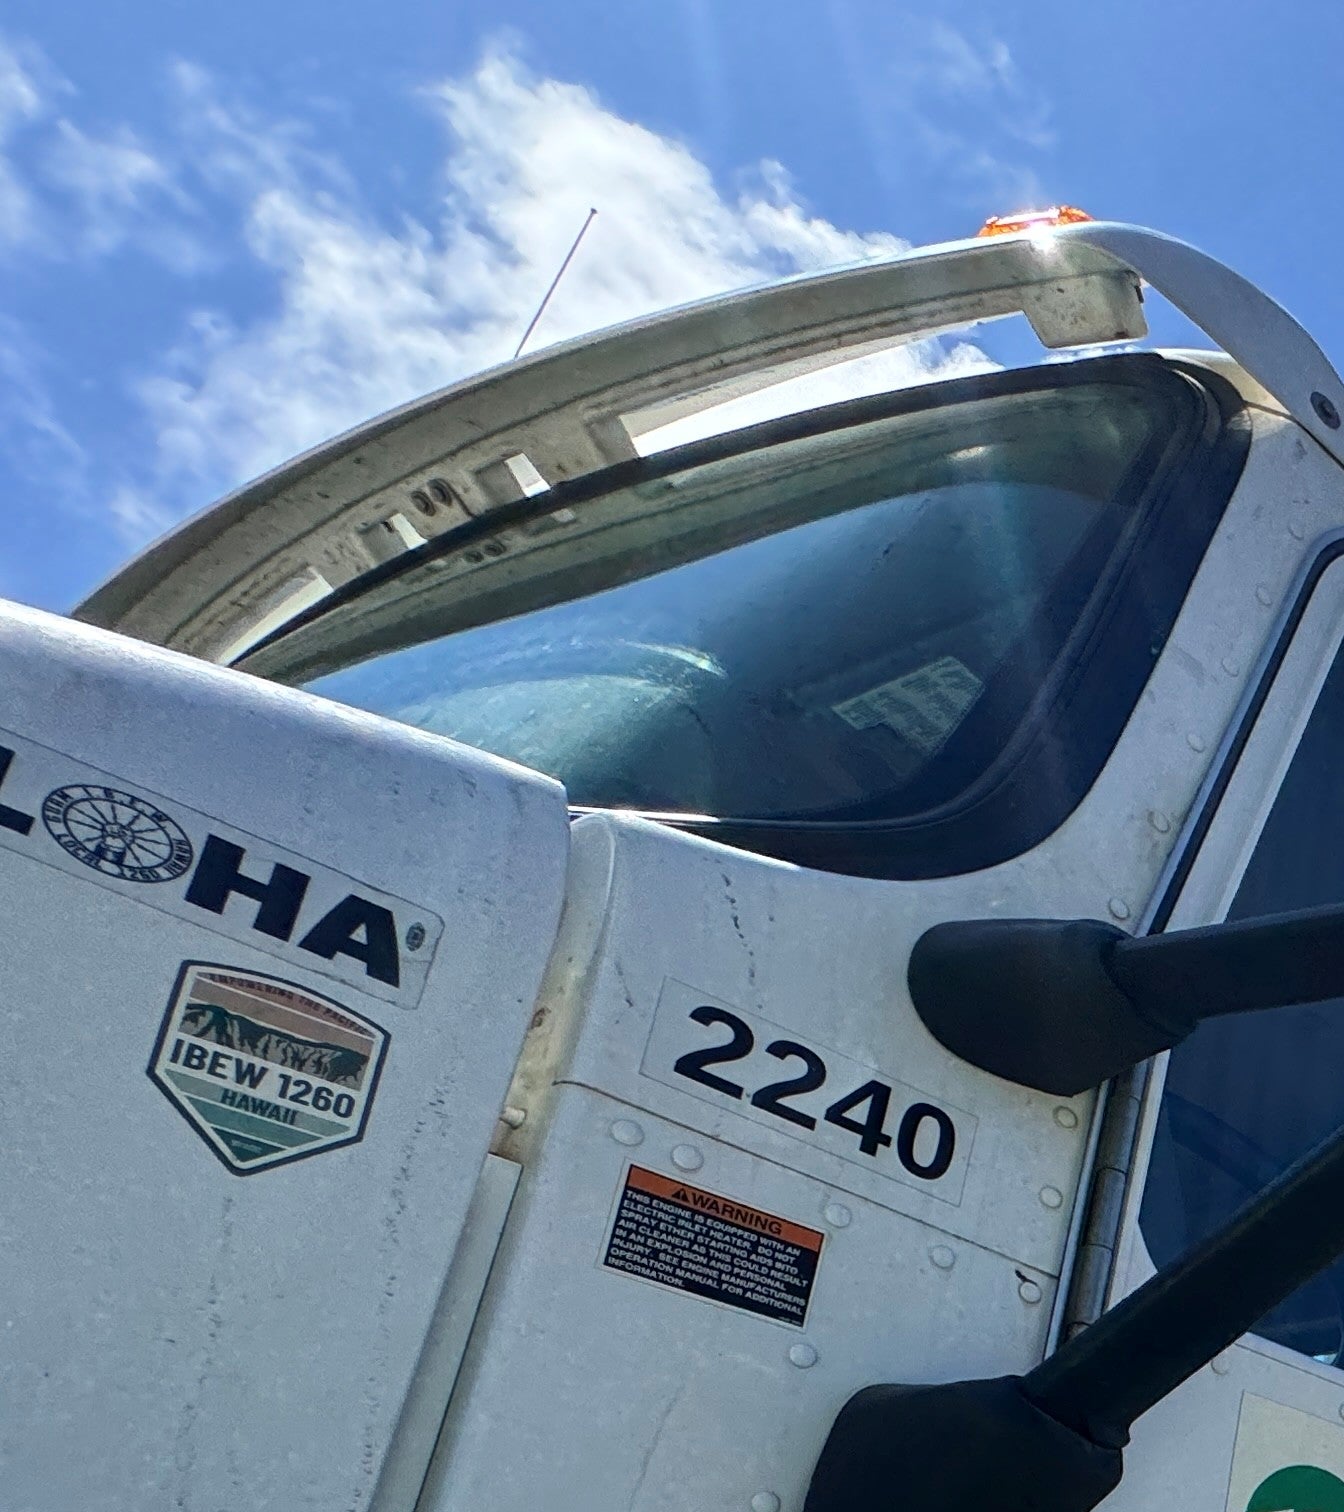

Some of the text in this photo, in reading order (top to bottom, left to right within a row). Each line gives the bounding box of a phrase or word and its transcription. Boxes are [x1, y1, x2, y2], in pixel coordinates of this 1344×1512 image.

[170, 1038, 356, 1119] IBEW 1260
[220, 1089, 297, 1126] HAWAII
[673, 1005, 956, 1180] 2240
[621, 1209, 657, 1227] SPRAY
[660, 1222, 694, 1239] ETHER
[697, 1235, 747, 1258] STARTING
[751, 1253, 772, 1266] AIDS
[624, 1199, 675, 1223] ELECTRIC
[679, 1218, 706, 1234] INLET
[758, 1246, 772, 1257] DO
[775, 1252, 795, 1265] NOT
[626, 1190, 800, 1257] THIS ENGINE IS EQUIPPED WITH AN
[690, 1191, 782, 1235] WARNING
[611, 1247, 802, 1315] OPERATION MANUAL FOR ADDITIONAL
[616, 1228, 786, 1290] IN AN EXPLOSION AND PERSONAL
[619, 1218, 807, 1287] AIR CLEANER AS THIS COULD RESULT
[659, 1252, 679, 1266] SEE
[682, 1260, 719, 1278] ENGINE
